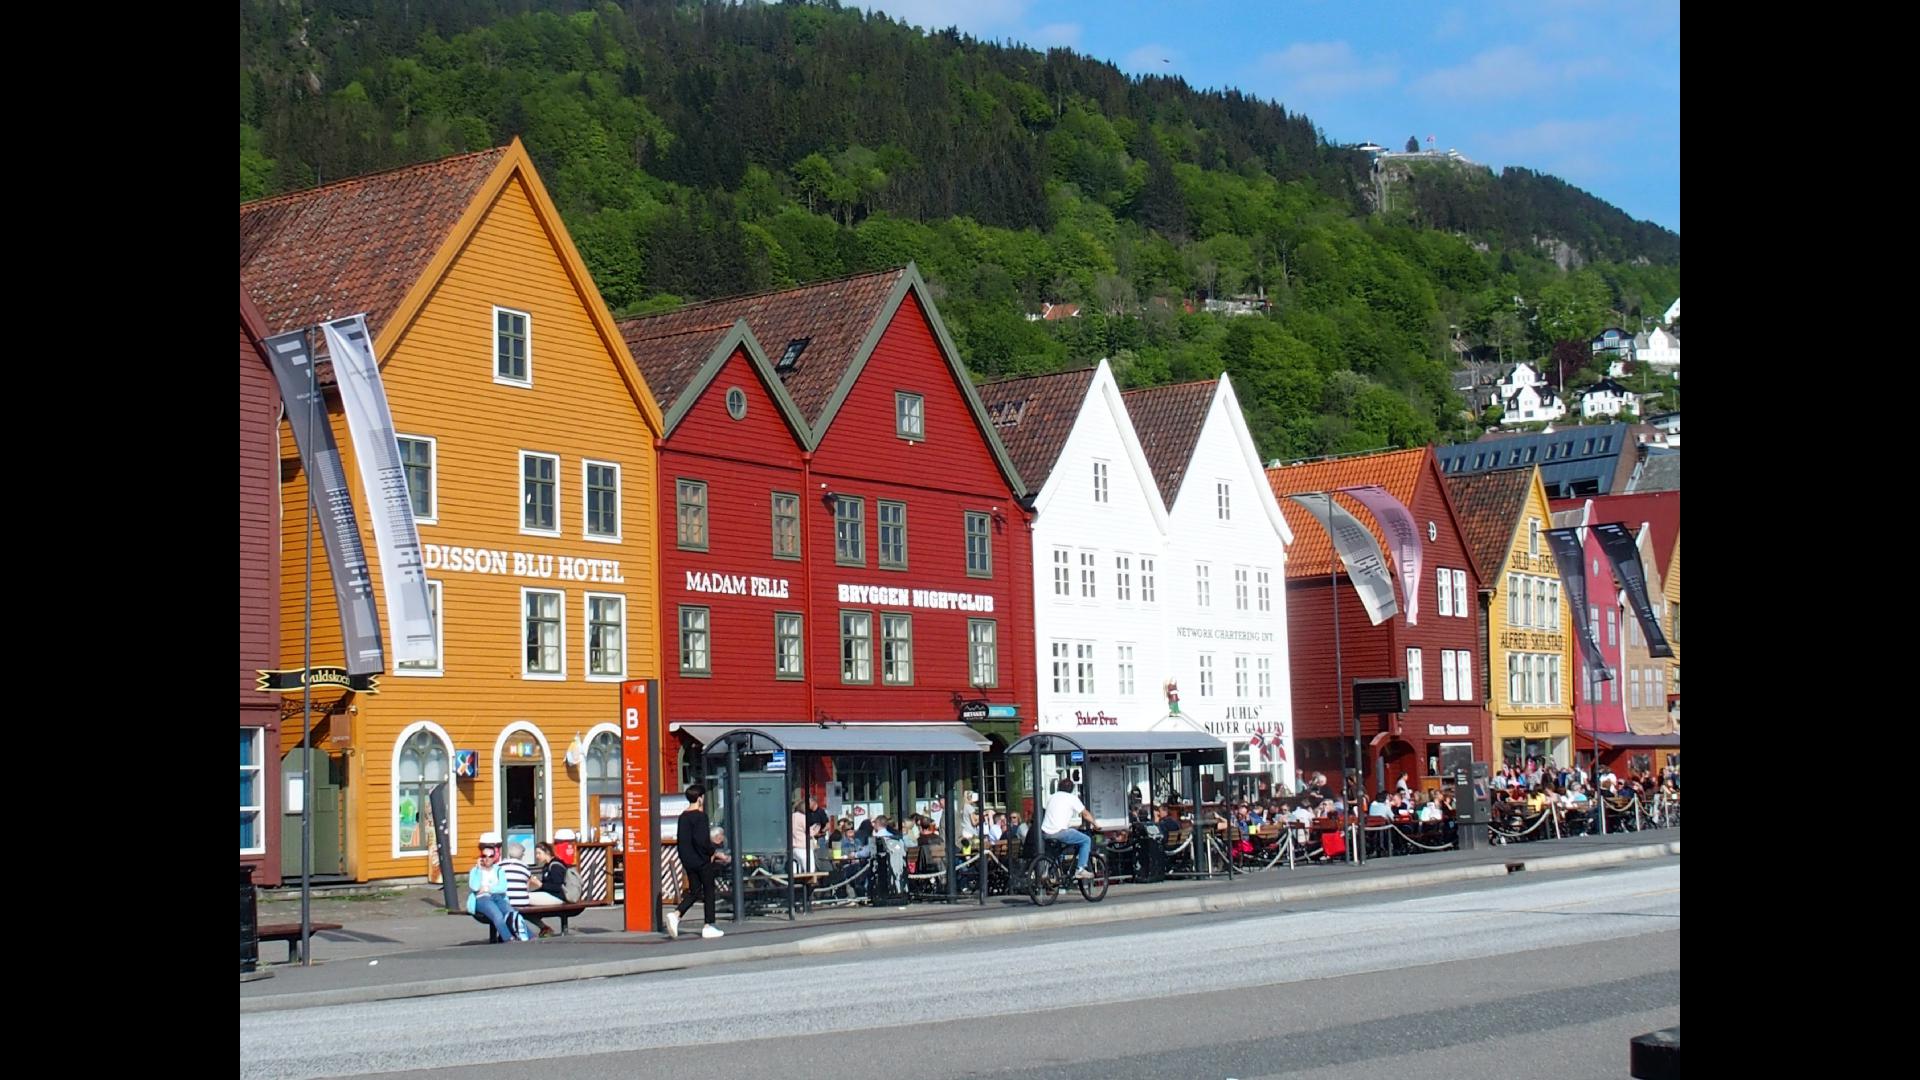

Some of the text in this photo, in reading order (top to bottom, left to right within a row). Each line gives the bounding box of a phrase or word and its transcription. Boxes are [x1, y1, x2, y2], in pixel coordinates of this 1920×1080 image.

[513, 552, 554, 578] BLU
[558, 556, 624, 583] HOTEL
[686, 571, 788, 598] MADAM FELLE
[838, 584, 994, 612] BRYGGEN NIGHTCLUB
[1176, 626, 1213, 638] NETWORK
[1214, 629, 1260, 640] CHARTERING
[1500, 631, 1526, 649] ALFRED
[626, 708, 638, 729] B
[1204, 721, 1239, 734] SILVER
